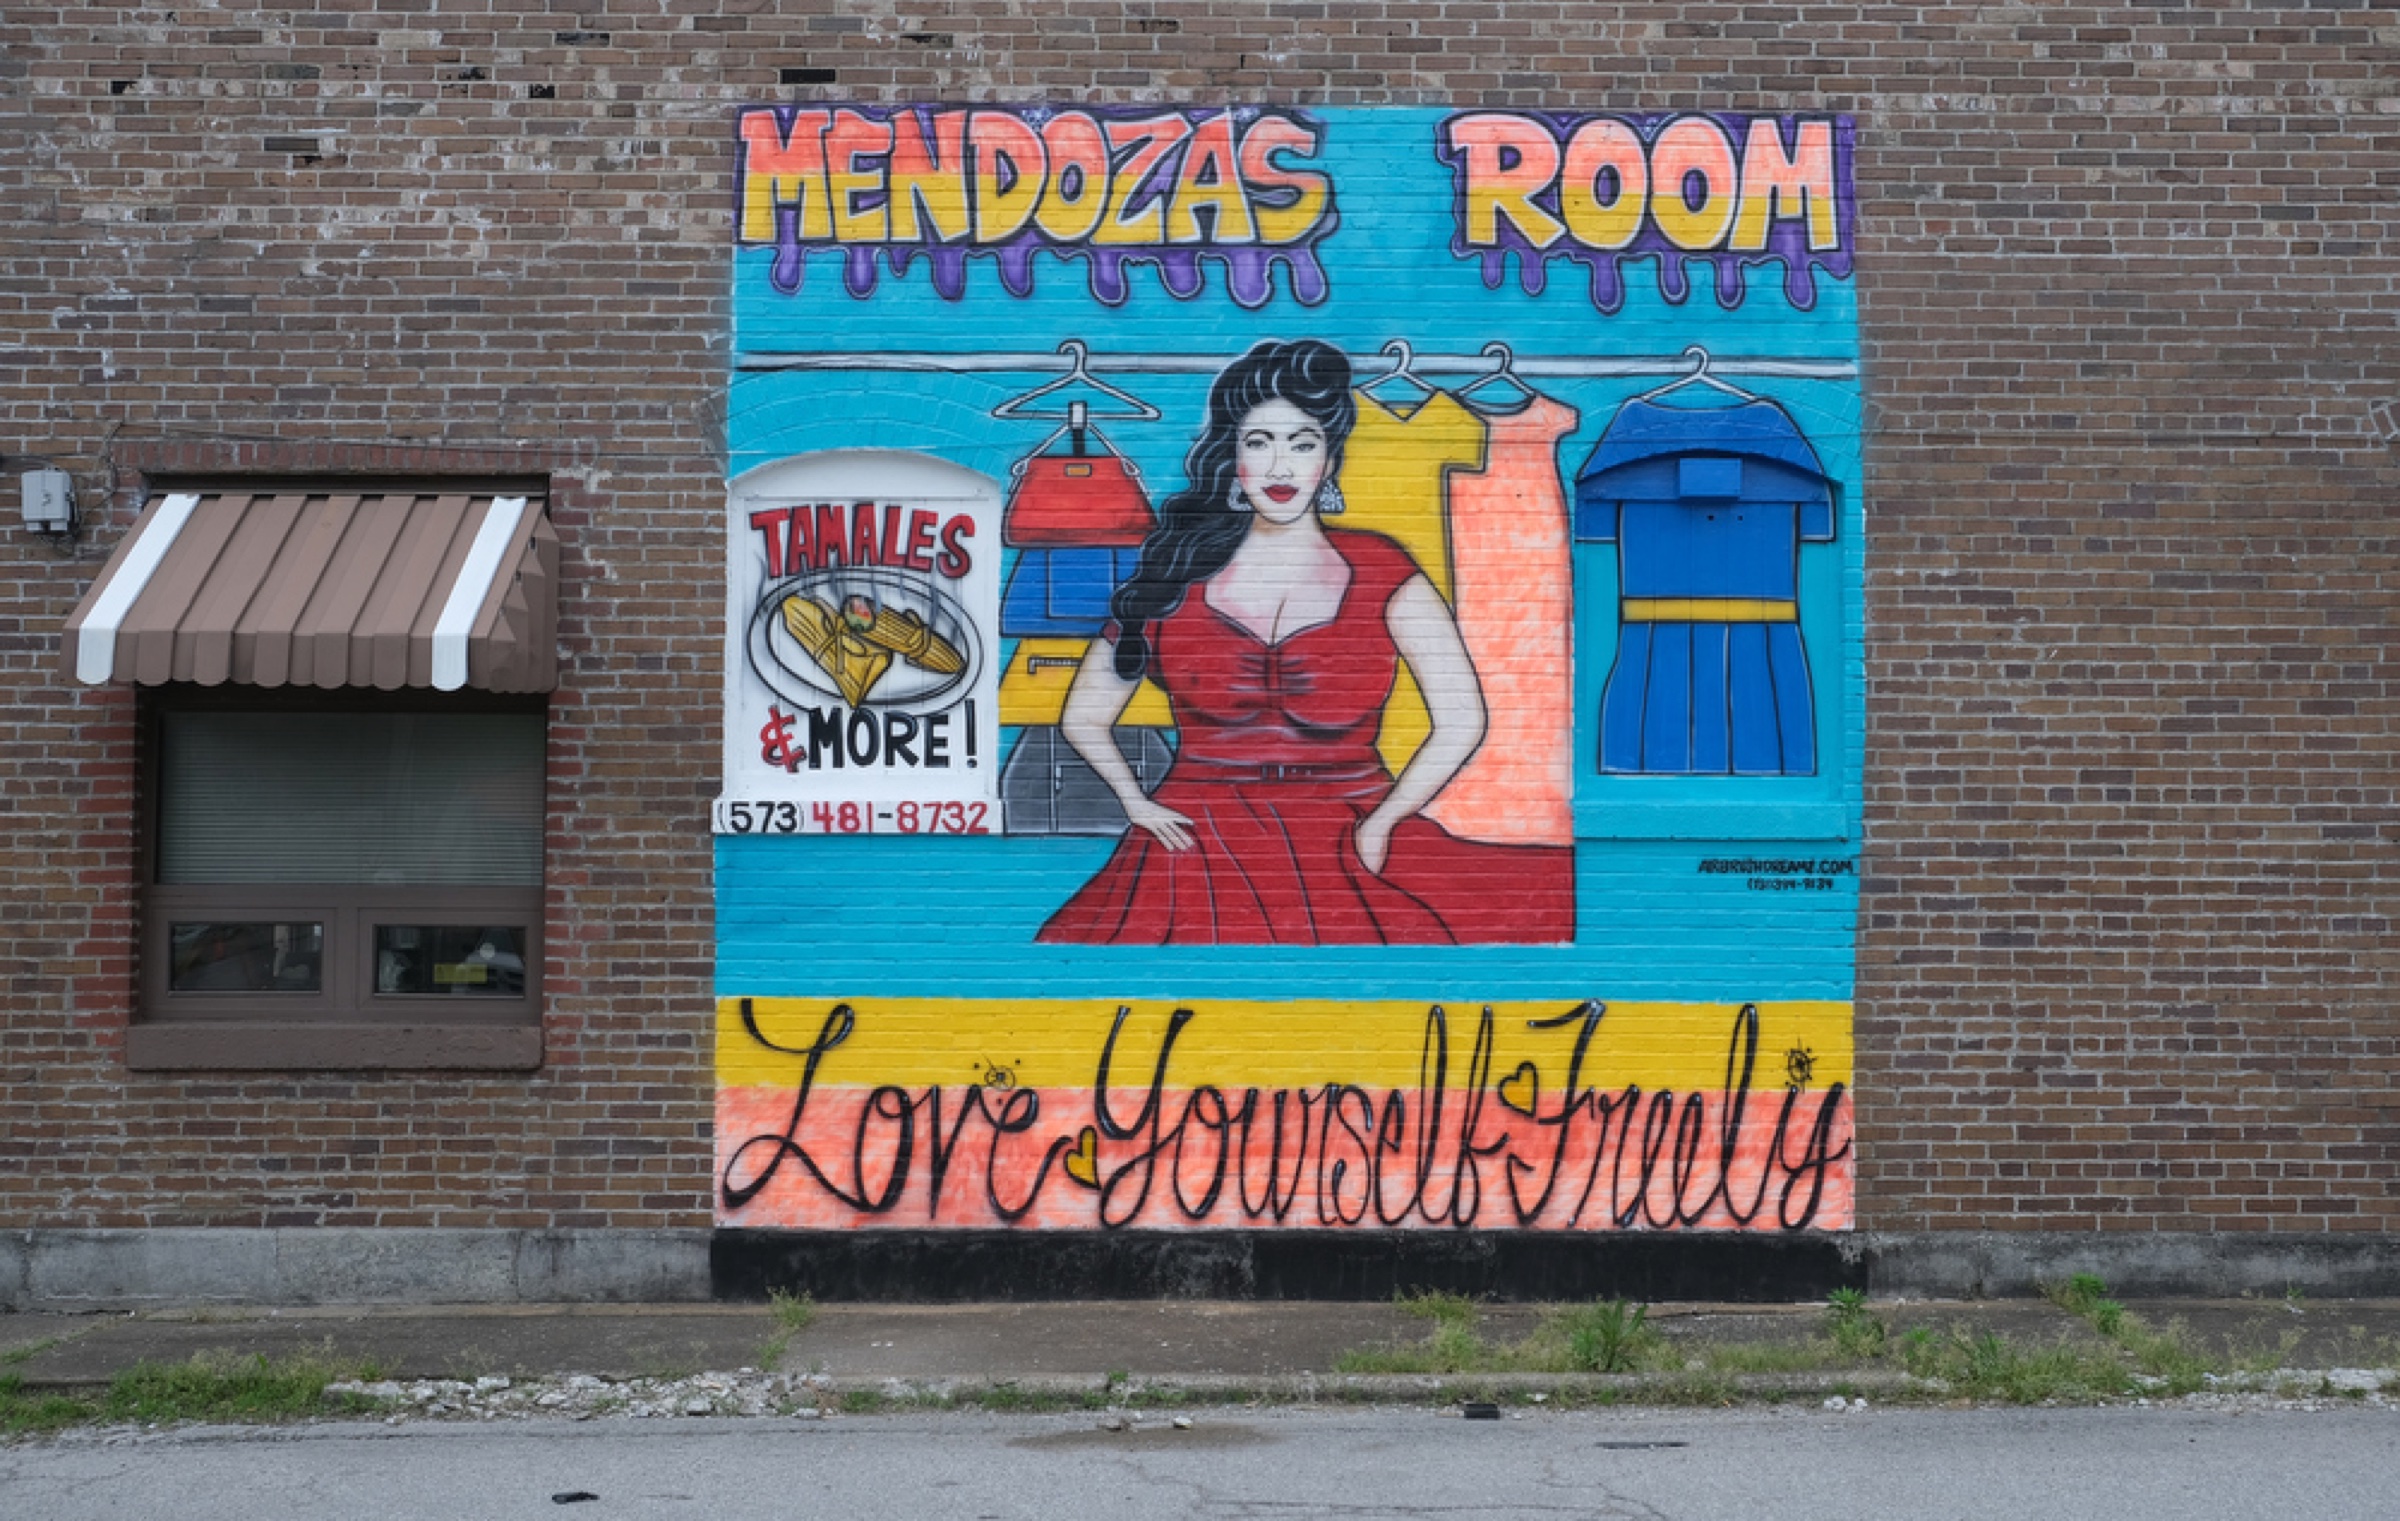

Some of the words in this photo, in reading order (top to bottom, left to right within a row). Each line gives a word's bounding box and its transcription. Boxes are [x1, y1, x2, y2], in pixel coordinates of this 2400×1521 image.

[738, 107, 1334, 244] MENDOZAS
[1447, 111, 1841, 251] ROOM
[750, 502, 976, 579] TAMALES
[760, 706, 808, 773] &
[717, 801, 804, 834] (573)
[812, 801, 989, 834] 481-8732
[723, 998, 1072, 1218] Love
[1096, 1005, 1509, 1227] Yourself
[1508, 999, 1851, 1229] Freely
